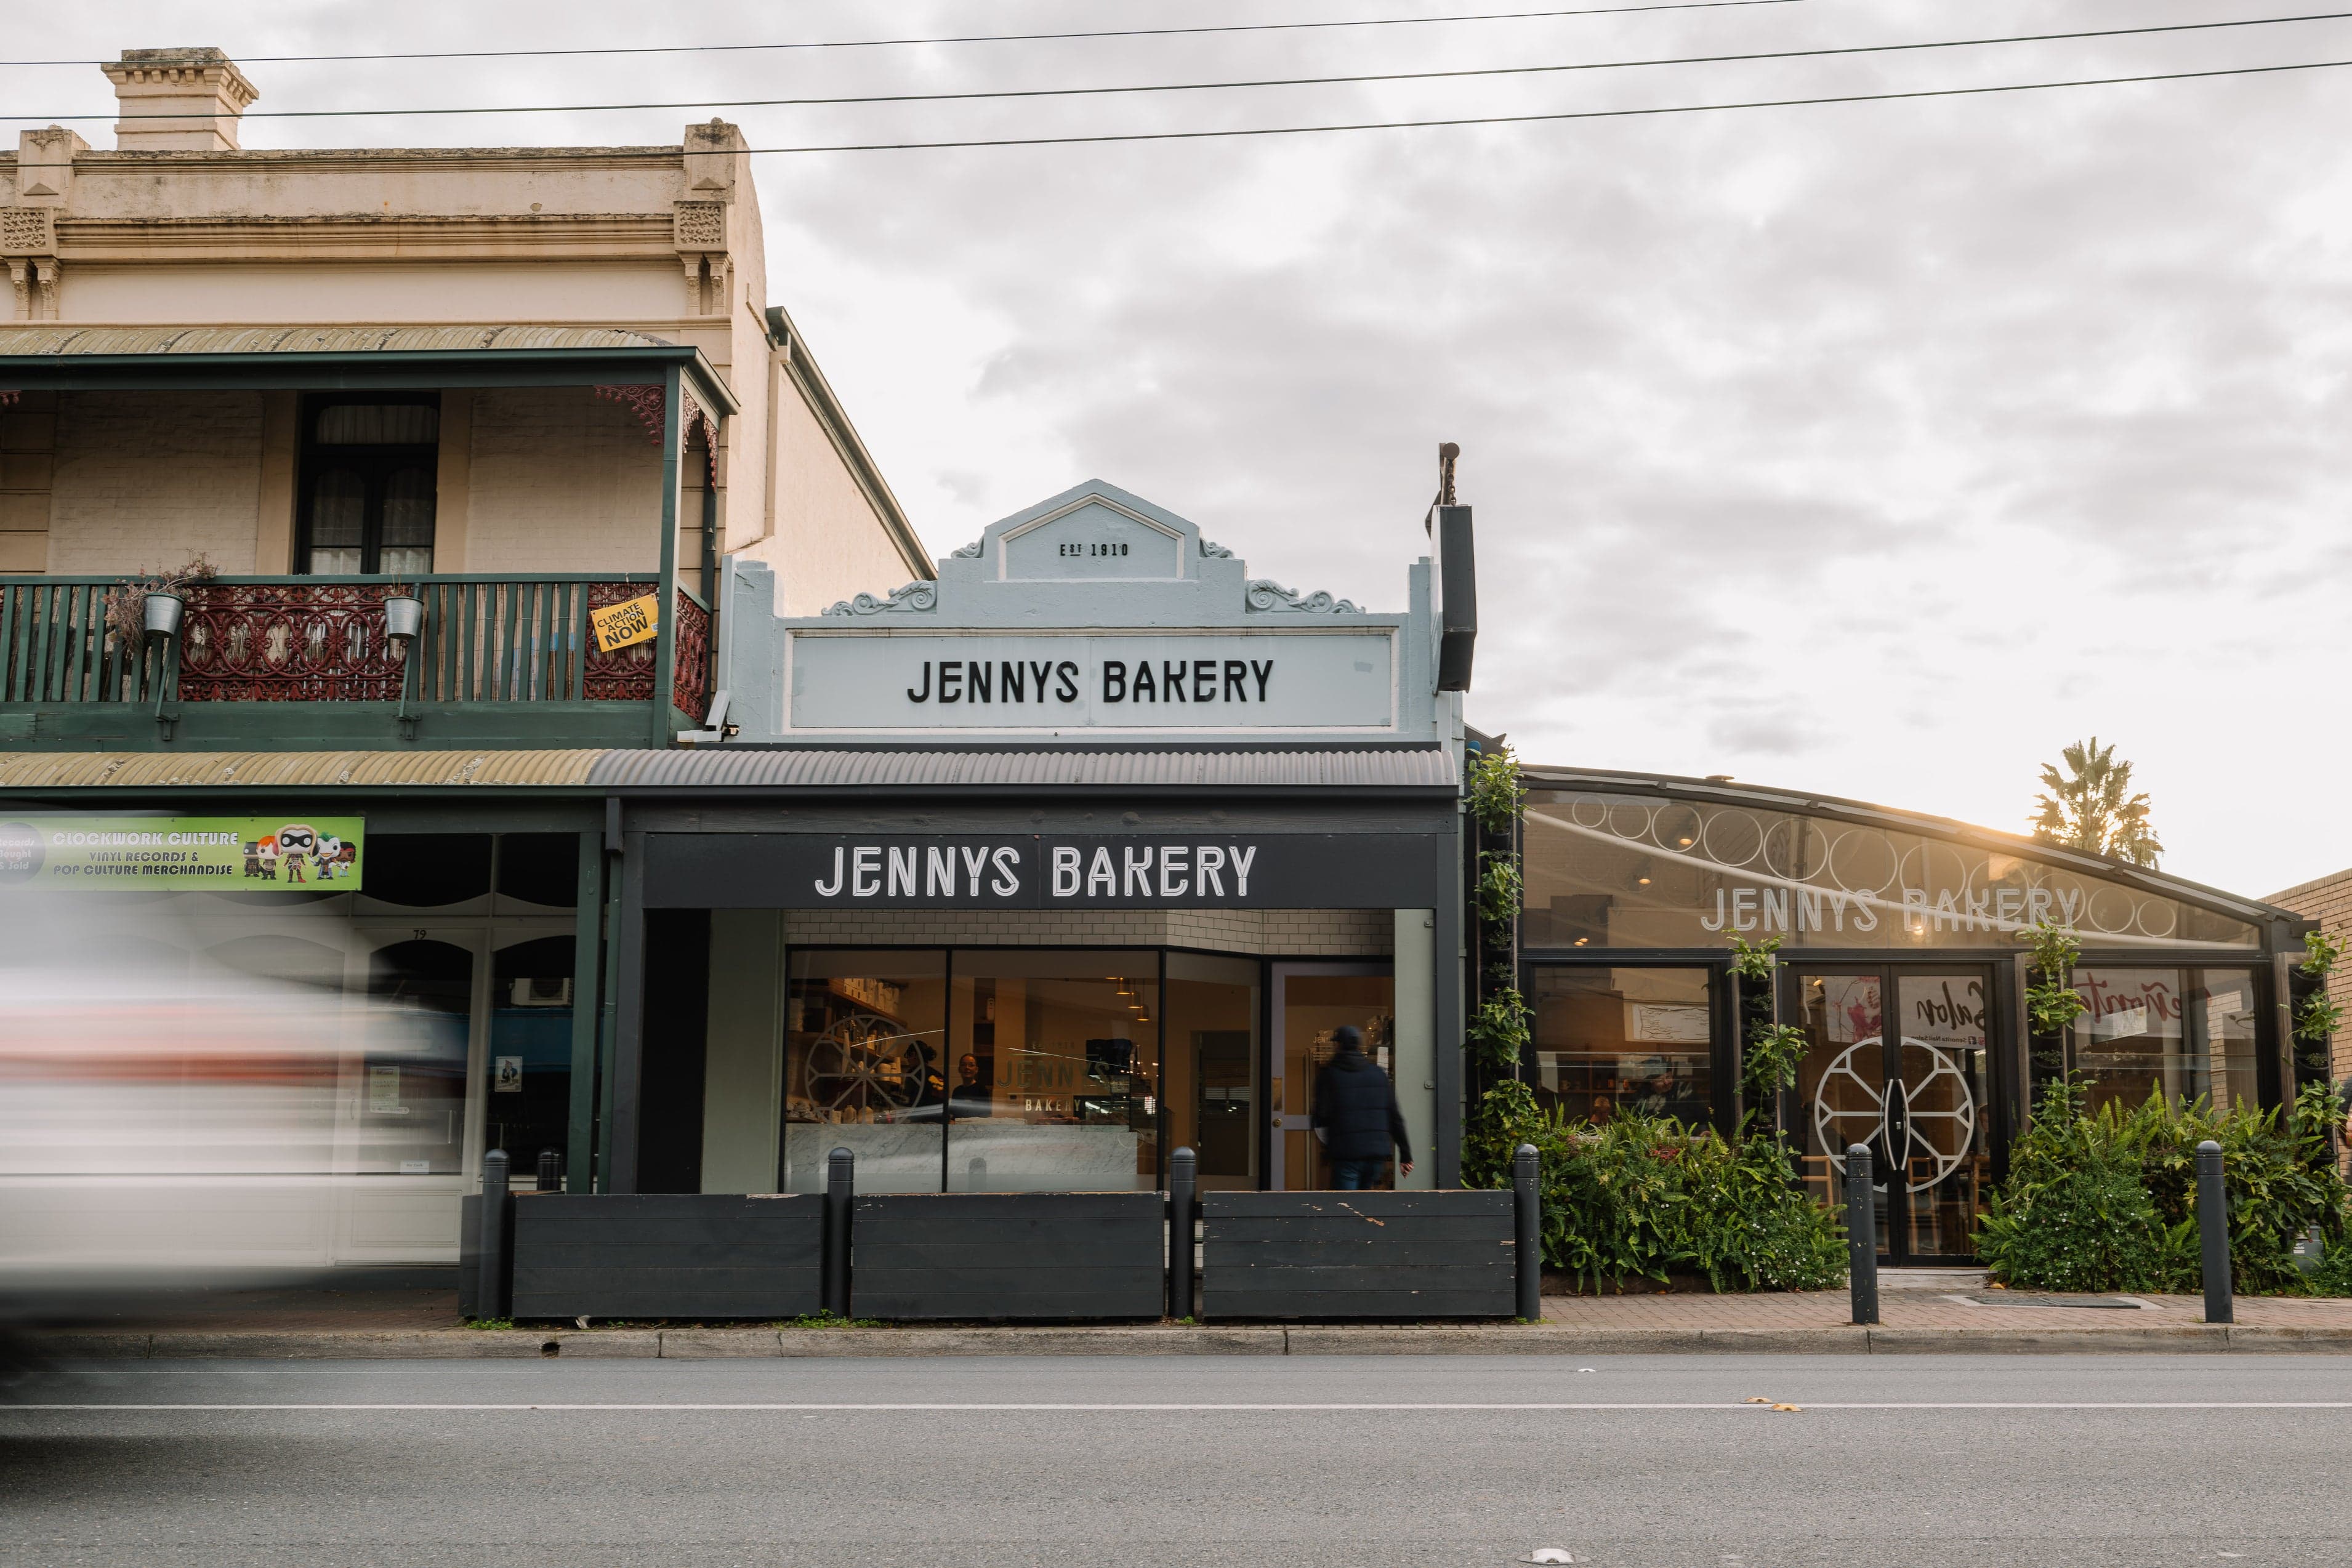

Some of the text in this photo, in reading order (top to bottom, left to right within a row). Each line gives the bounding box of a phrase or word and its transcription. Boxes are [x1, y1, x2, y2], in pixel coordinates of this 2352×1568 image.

[1091, 544, 1128, 556] 1910
[597, 602, 640, 627] CLIMATE
[608, 609, 644, 632] ACTION
[605, 616, 648, 647] NOW
[907, 660, 1274, 703] JENNYS BAKERY
[52, 832, 238, 845] CLOCKWORK CULTURE
[89, 851, 199, 862] VINYL RECORDS &
[54, 864, 233, 875] POP CULTURE MERCHANDISE
[815, 846, 1257, 897] JENNYS BAKERY
[1700, 888, 2079, 932] JENNYS BAKERY
[413, 930, 427, 940] 79
[997, 1059, 1111, 1090] JENNYS
[1025, 1099, 1081, 1111] BAKERY
